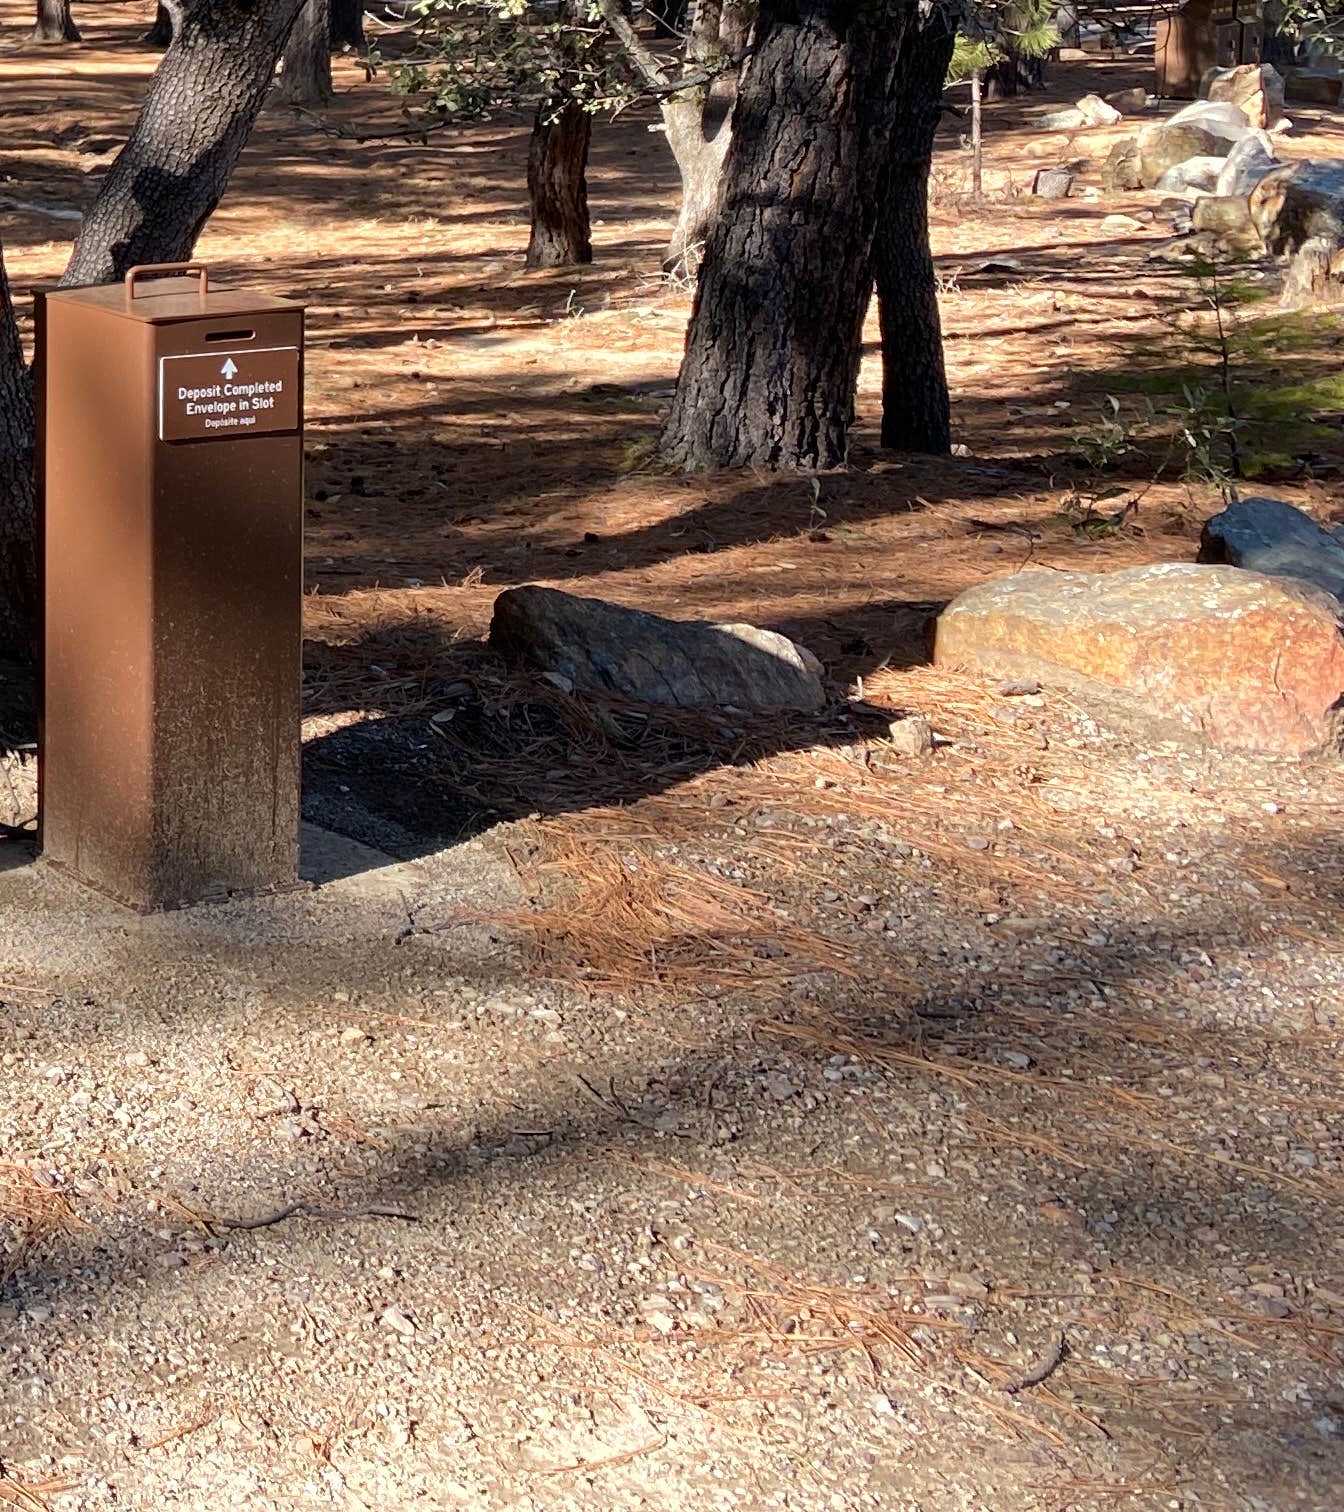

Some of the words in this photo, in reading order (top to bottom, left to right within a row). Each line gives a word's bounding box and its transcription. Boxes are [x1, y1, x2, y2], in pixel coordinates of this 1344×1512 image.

[178, 385, 221, 401] Deposit
[224, 380, 283, 398] Completed
[186, 401, 236, 415] Envelope
[239, 399, 249, 411] in
[252, 397, 275, 410] Slot
